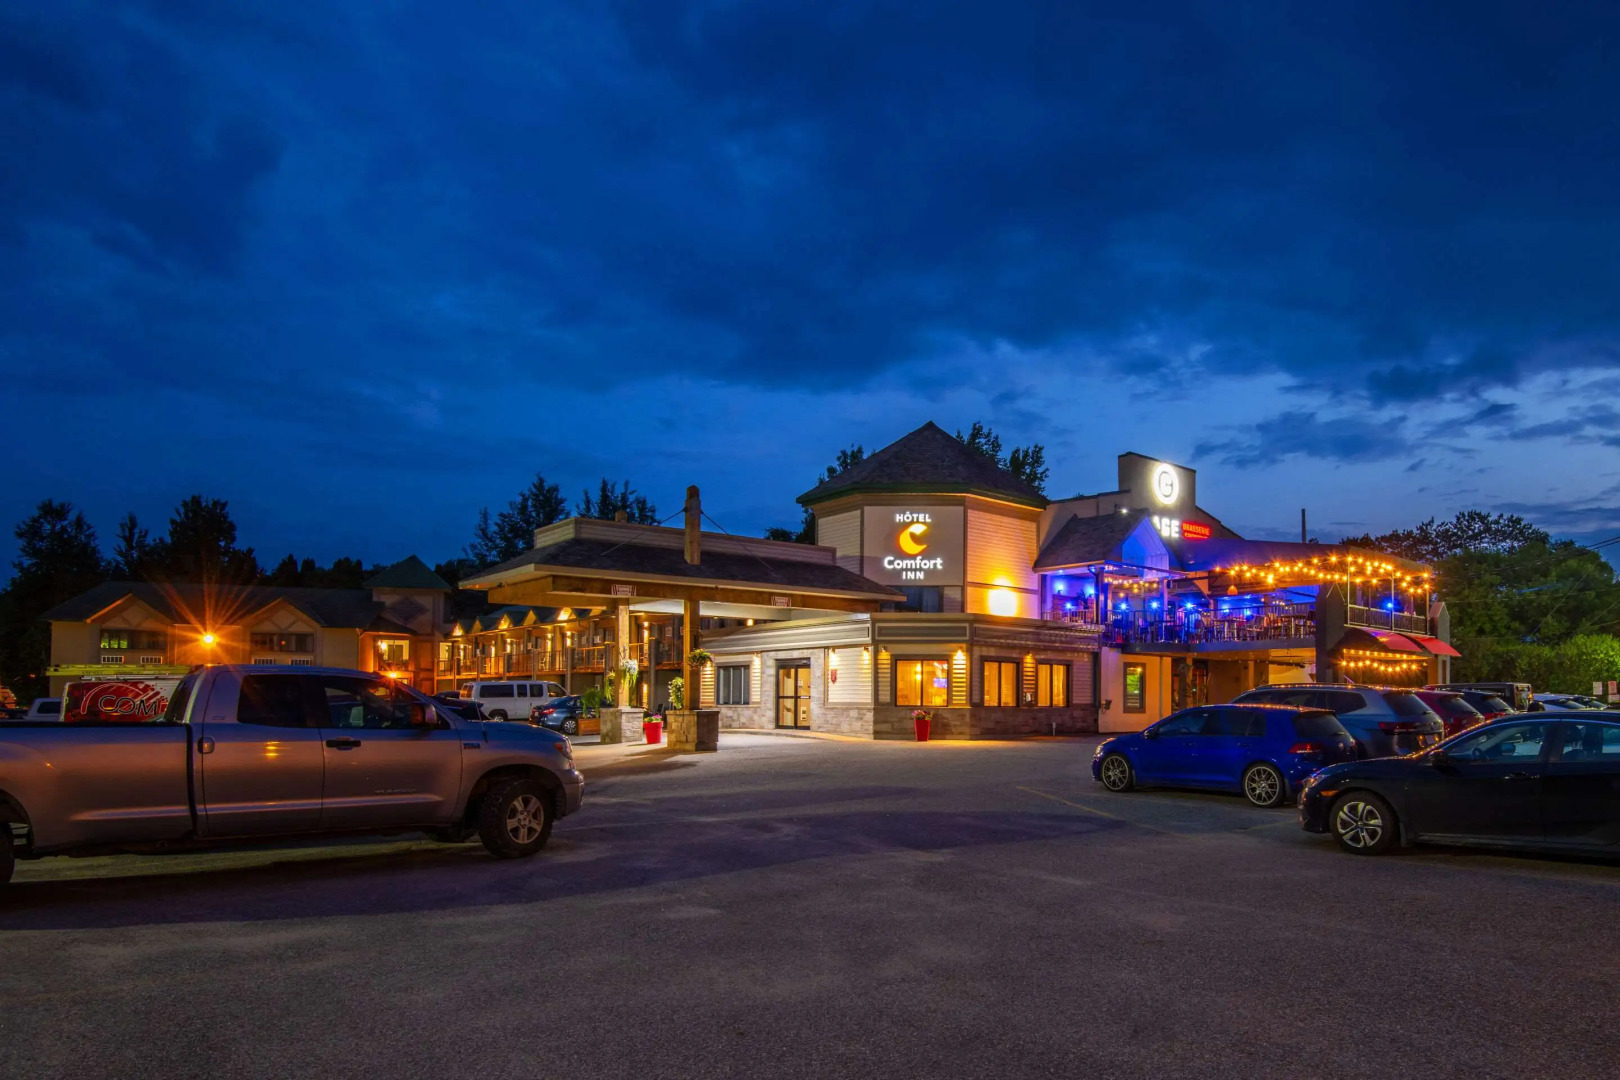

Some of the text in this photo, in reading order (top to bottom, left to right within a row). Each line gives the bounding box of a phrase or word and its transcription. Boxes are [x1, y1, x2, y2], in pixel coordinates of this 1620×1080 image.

[895, 511, 932, 522] HÔTEL
[884, 556, 943, 569] Comfort
[902, 571, 924, 580] INN
